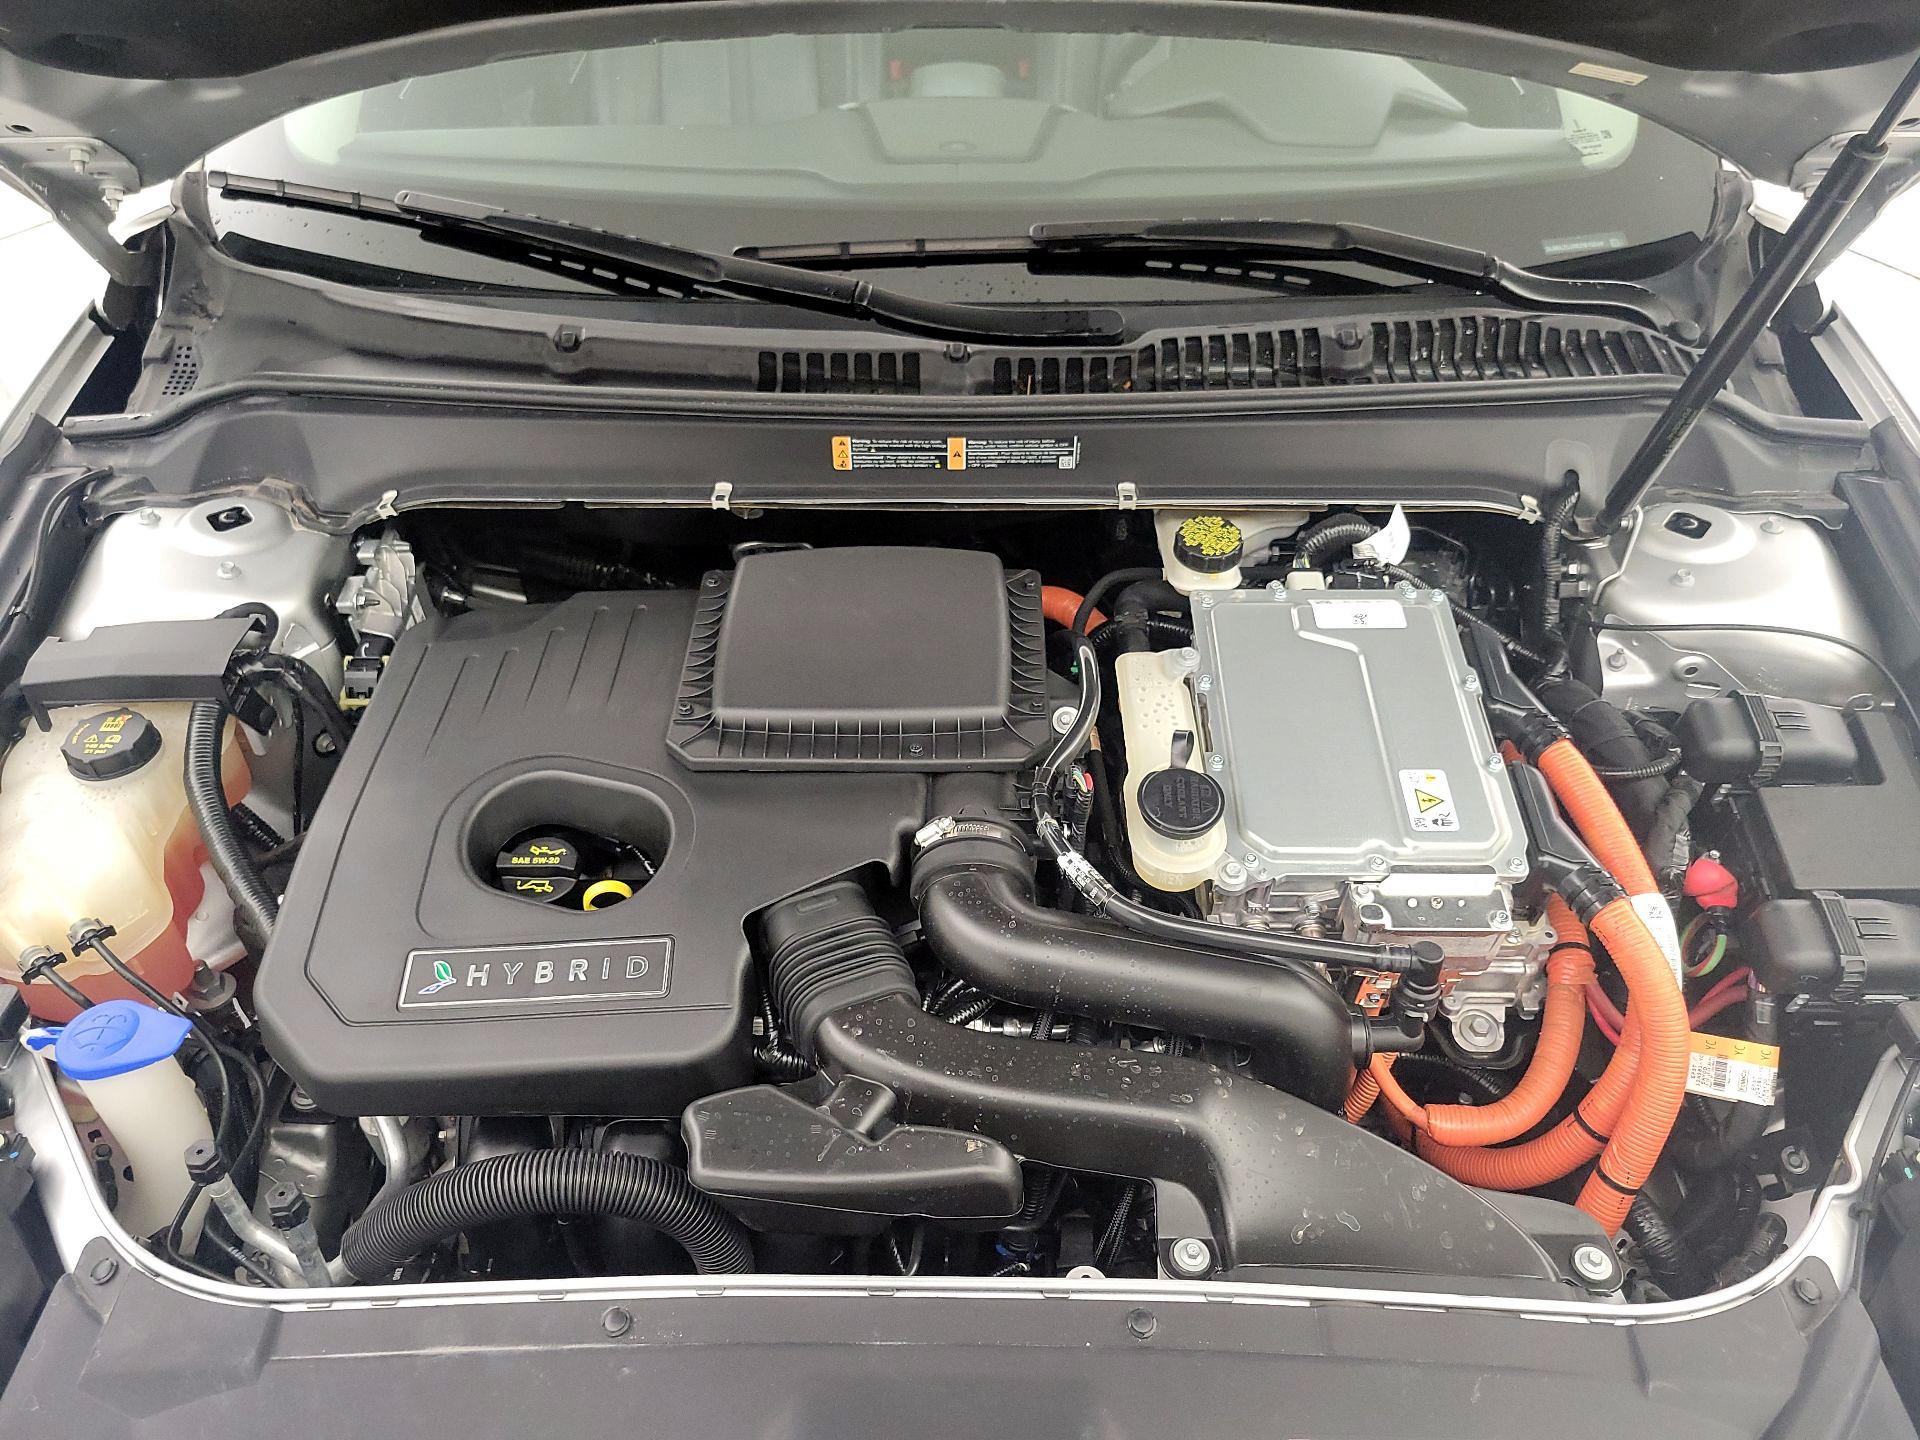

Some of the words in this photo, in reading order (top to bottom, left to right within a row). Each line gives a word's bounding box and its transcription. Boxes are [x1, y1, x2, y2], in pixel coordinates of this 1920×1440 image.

[1163, 784, 1173, 808] ONLY
[1176, 776, 1188, 819] COOLANT
[511, 856, 531, 864] SAE
[532, 856, 560, 864] 5W-20
[466, 955, 649, 987] HYBRID
